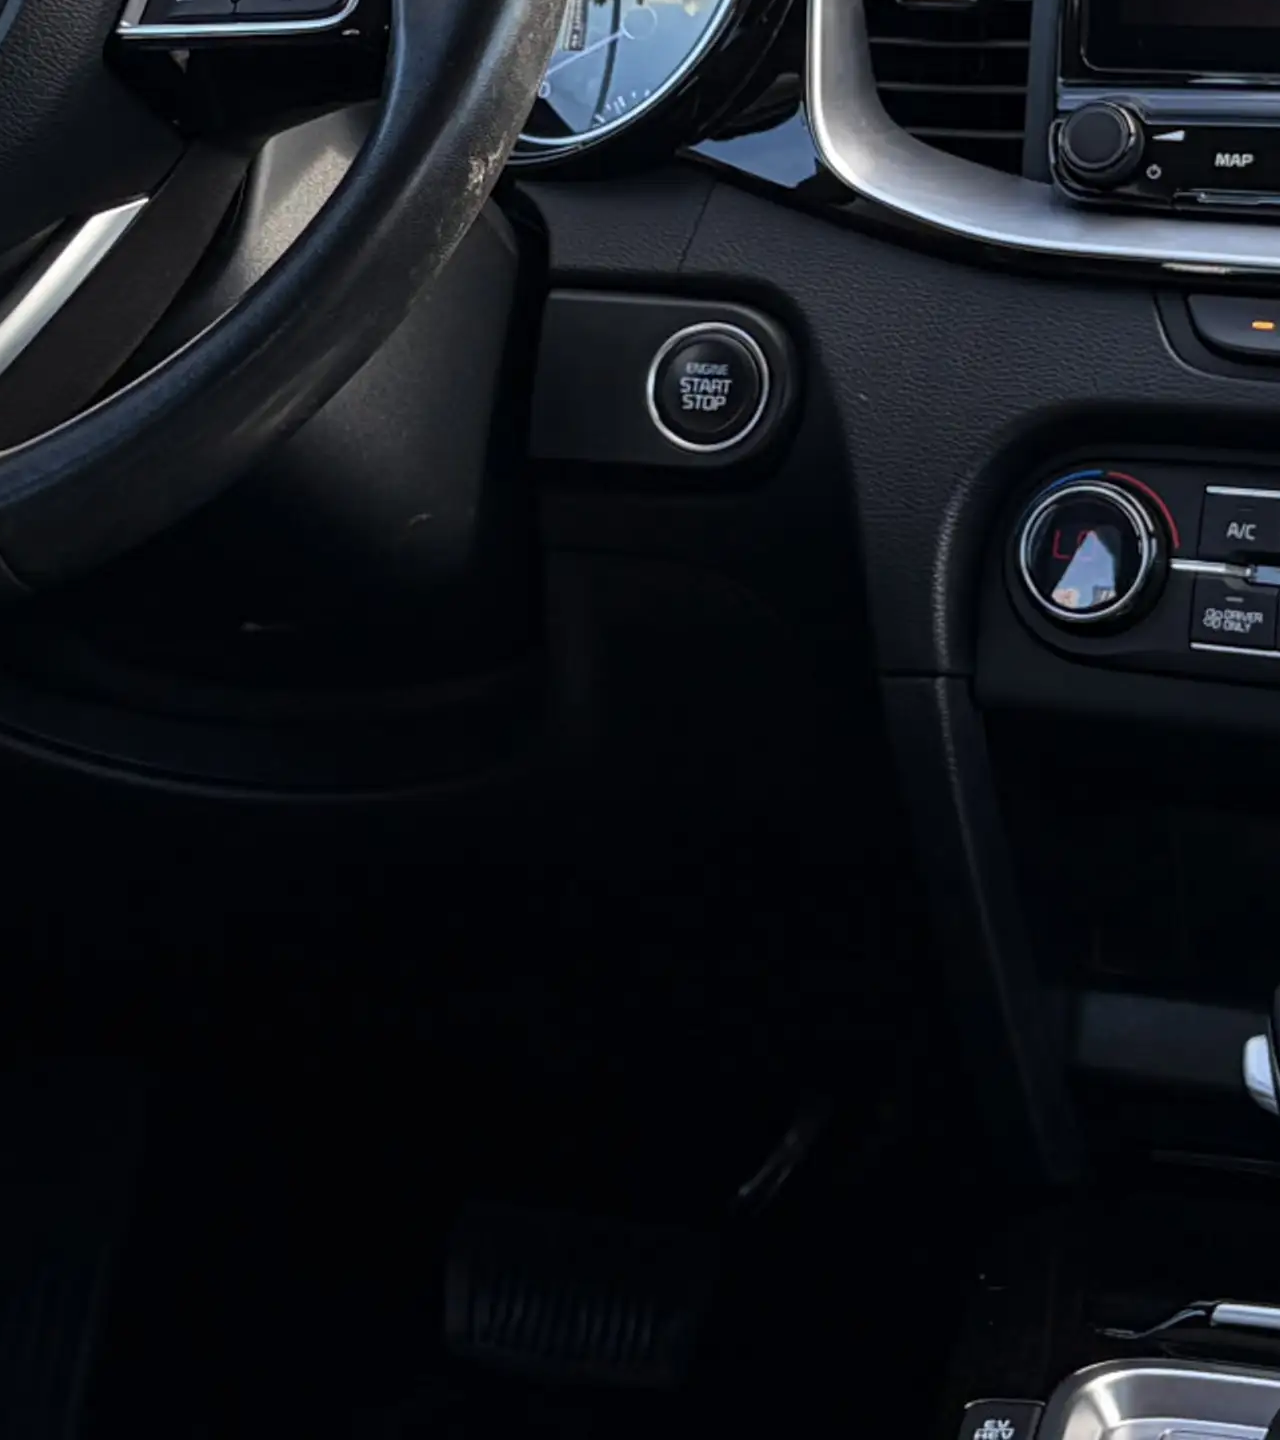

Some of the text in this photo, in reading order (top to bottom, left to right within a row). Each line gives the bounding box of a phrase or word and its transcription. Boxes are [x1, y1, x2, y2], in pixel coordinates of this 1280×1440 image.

[1214, 153, 1255, 168] MAP
[679, 376, 733, 395] START
[681, 393, 728, 411] STOP
[1226, 521, 1257, 541] A/C
[1223, 608, 1264, 625] DRIVER
[1222, 619, 1252, 634] ONLY
